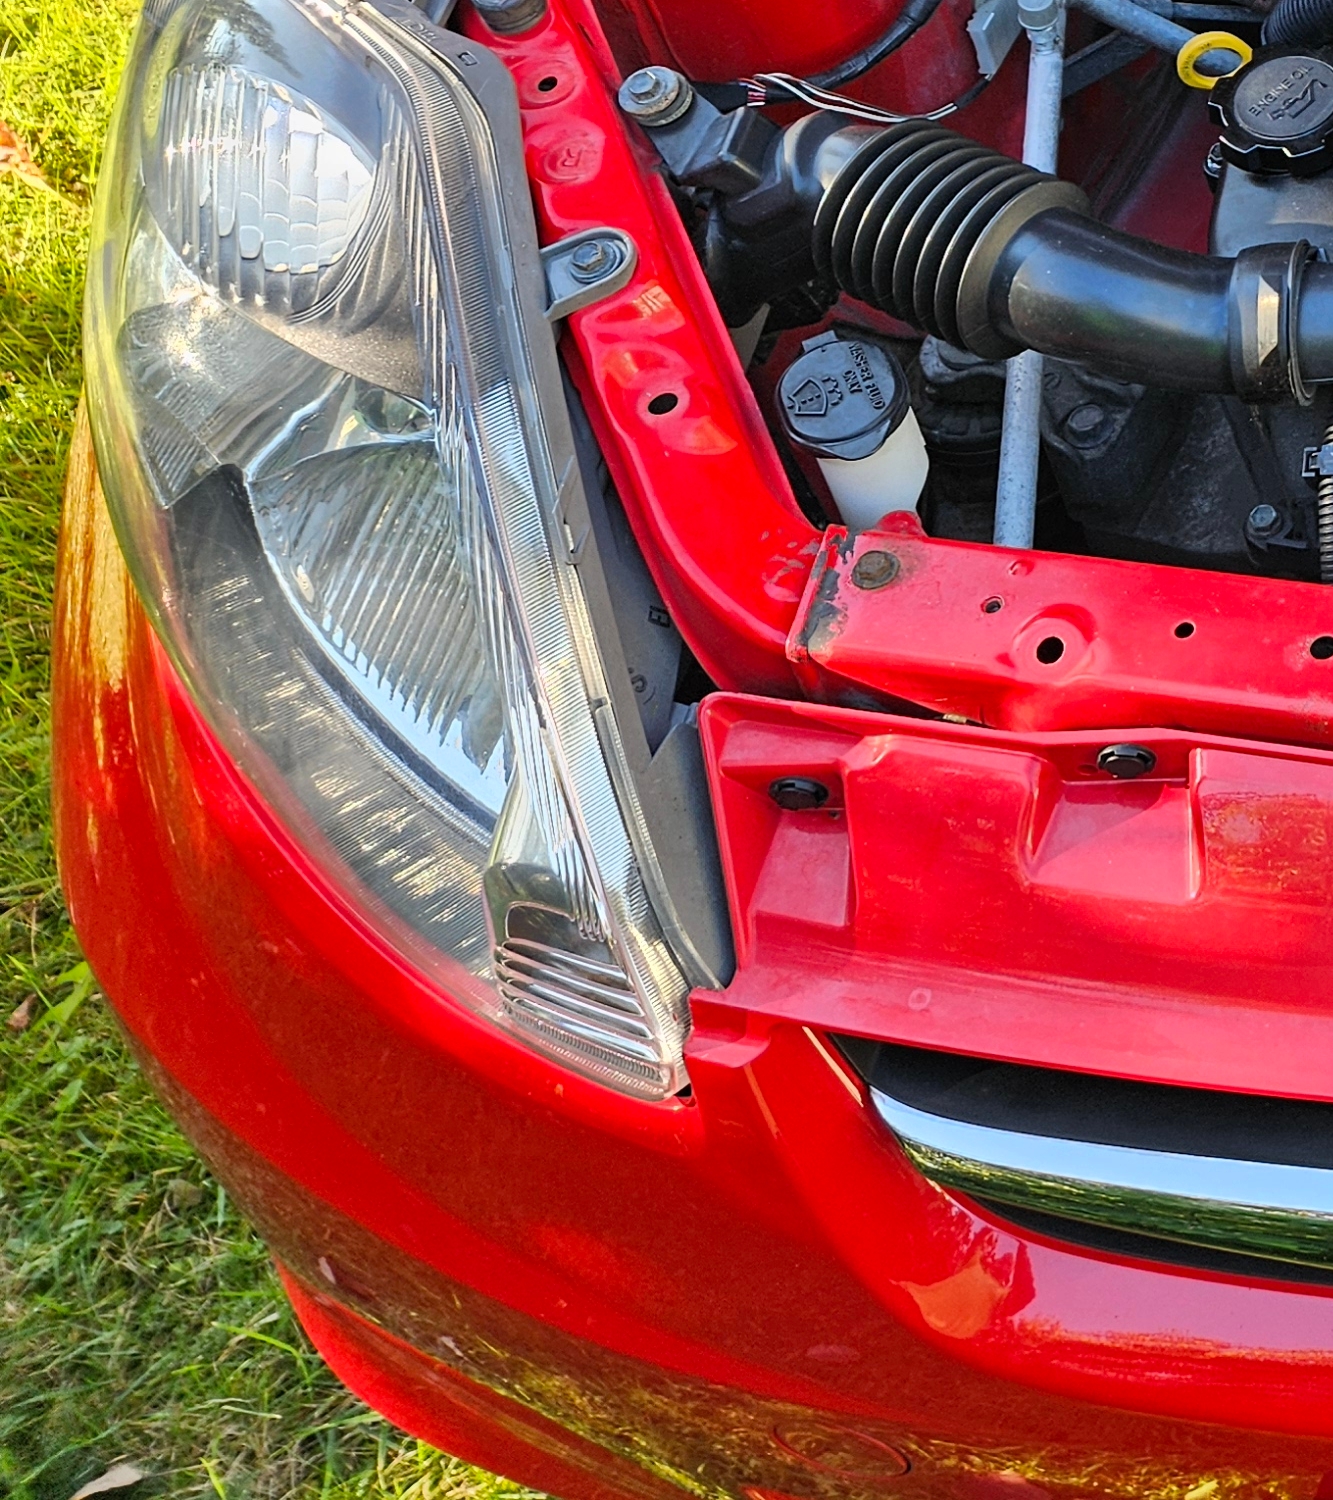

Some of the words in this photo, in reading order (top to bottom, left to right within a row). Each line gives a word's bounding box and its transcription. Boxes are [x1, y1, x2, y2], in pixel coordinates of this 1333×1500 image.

[1248, 77, 1295, 117] ENGINE
[1291, 64, 1314, 81] OIL
[842, 369, 863, 394] ONLY
[848, 342, 874, 381] WASHER
[865, 381, 887, 410] FLUID
